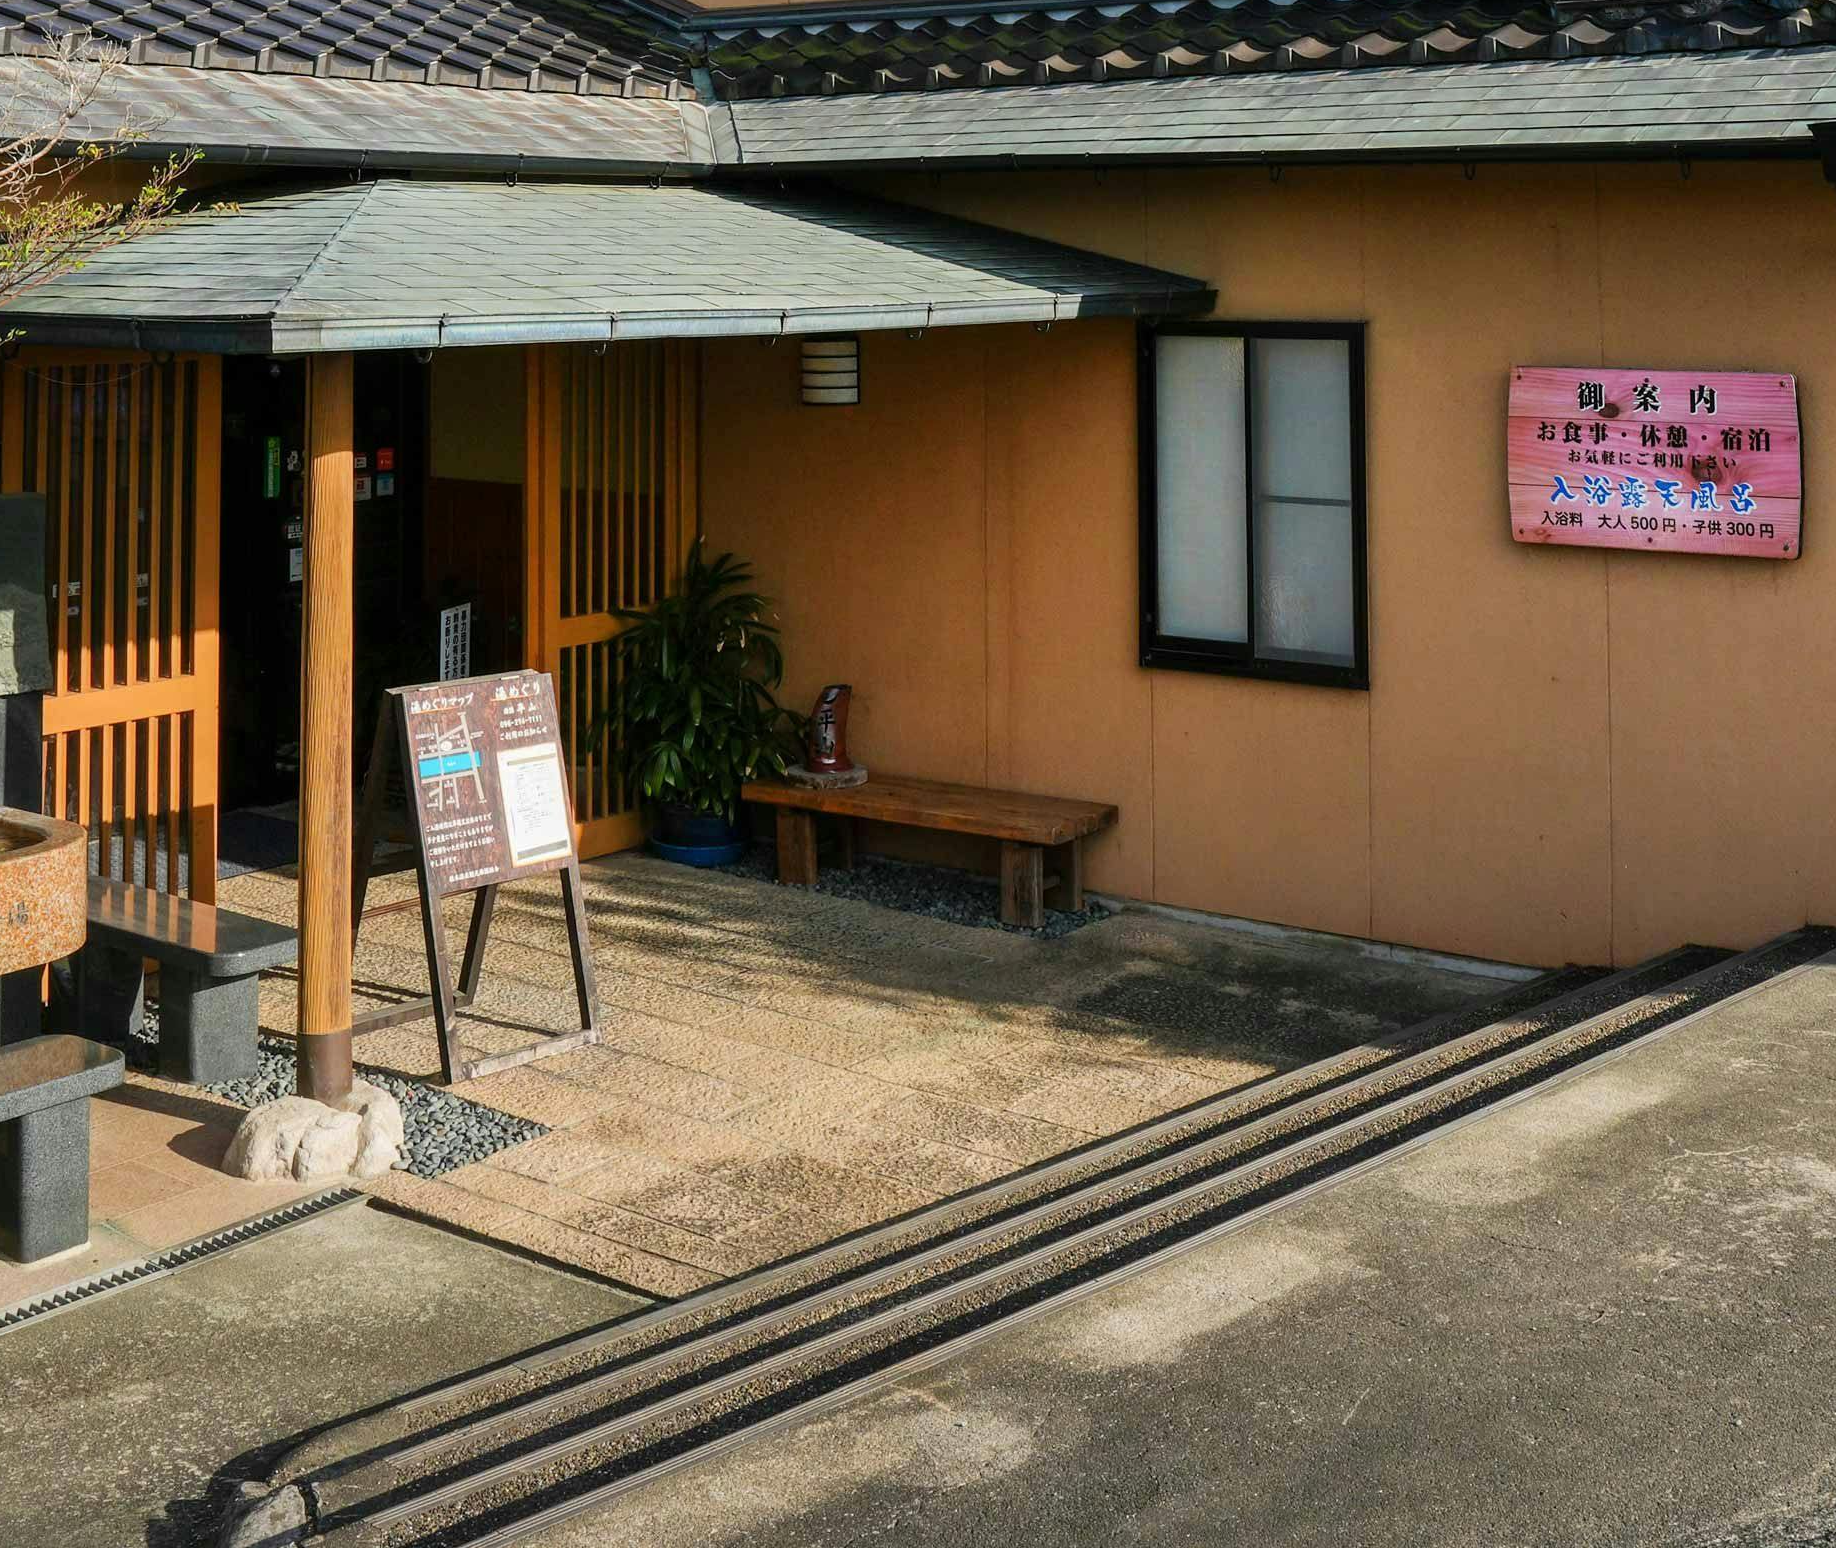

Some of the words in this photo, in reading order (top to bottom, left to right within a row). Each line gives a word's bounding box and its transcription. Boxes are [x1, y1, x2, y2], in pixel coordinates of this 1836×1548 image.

[1577, 381, 1718, 415] 御案内
[1568, 450, 1737, 469] お気軽にご利用下さい
[1549, 474, 1757, 514] 入浴露天風呂
